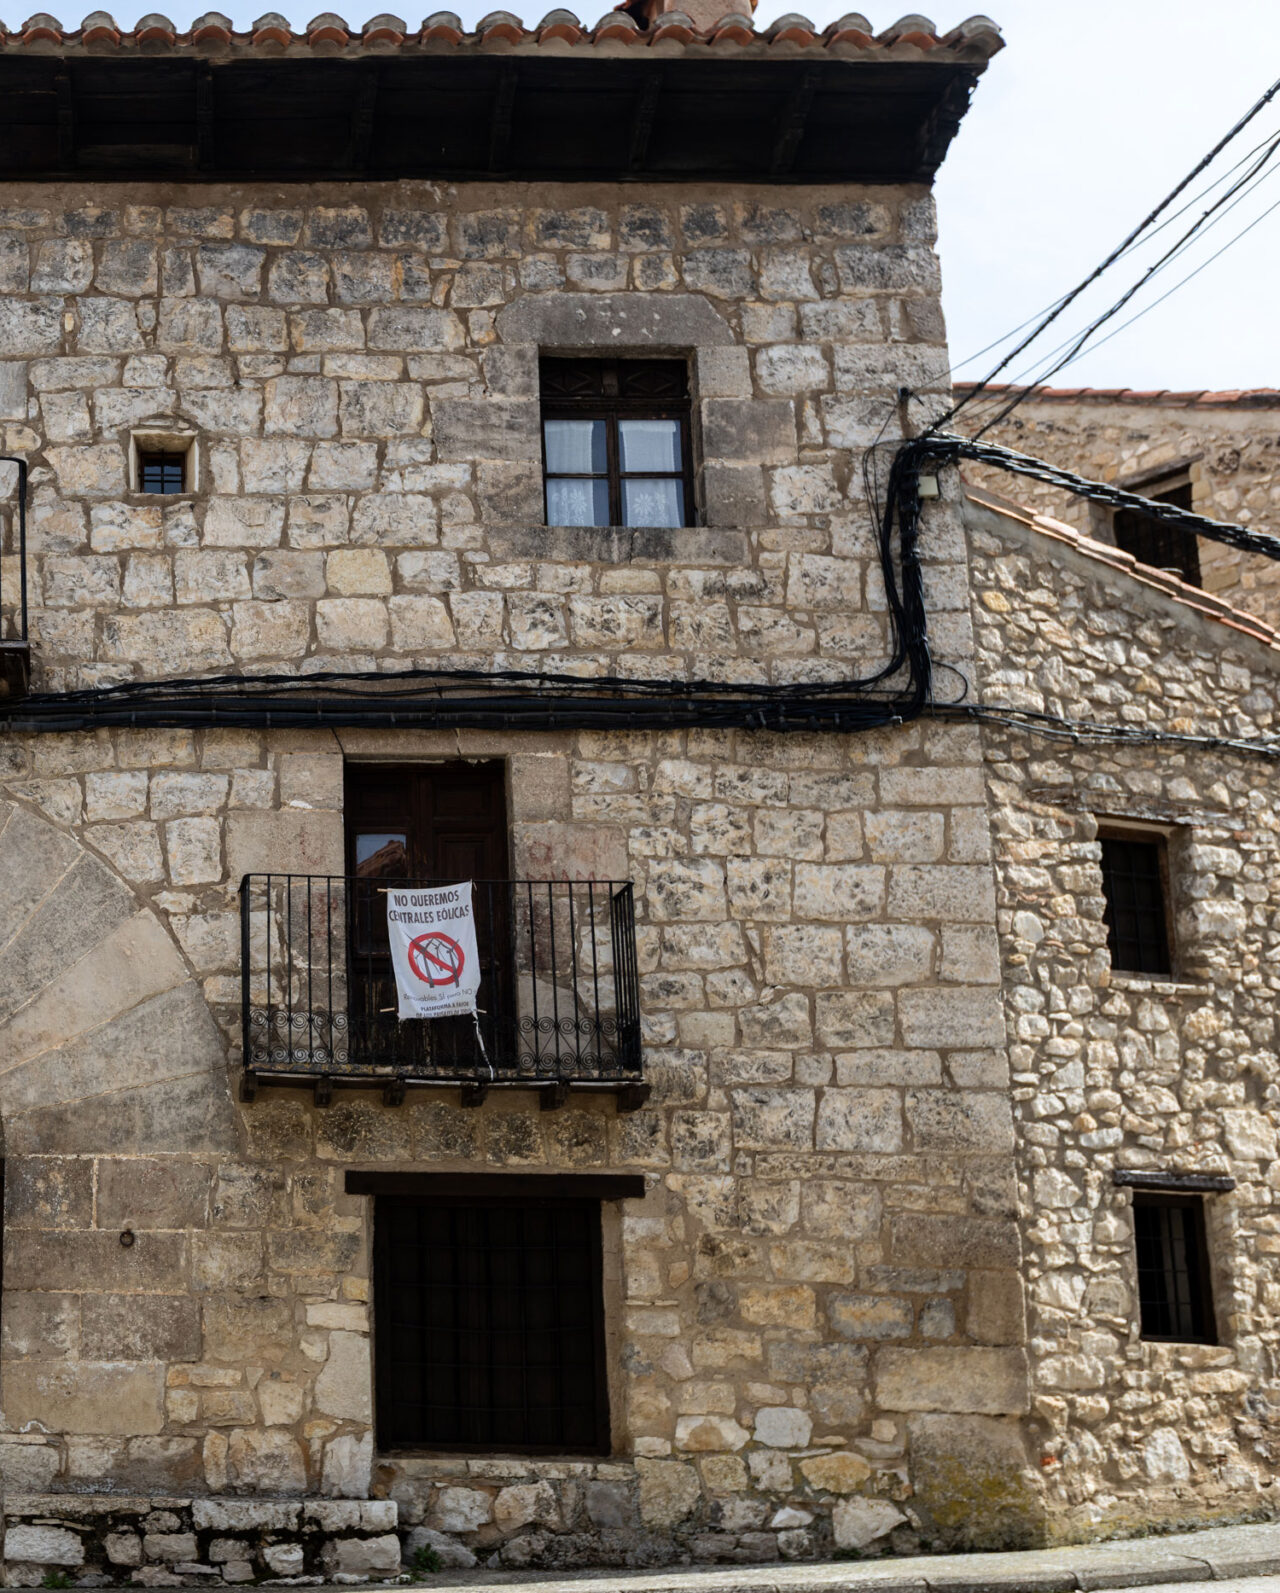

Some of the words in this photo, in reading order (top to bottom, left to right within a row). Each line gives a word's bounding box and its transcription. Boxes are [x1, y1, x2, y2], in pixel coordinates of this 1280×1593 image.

[394, 894, 408, 907] NO
[410, 890, 460, 907] QUEREMOS
[388, 910, 434, 924] CENTRALES
[436, 904, 470, 922] EÓLICAS
